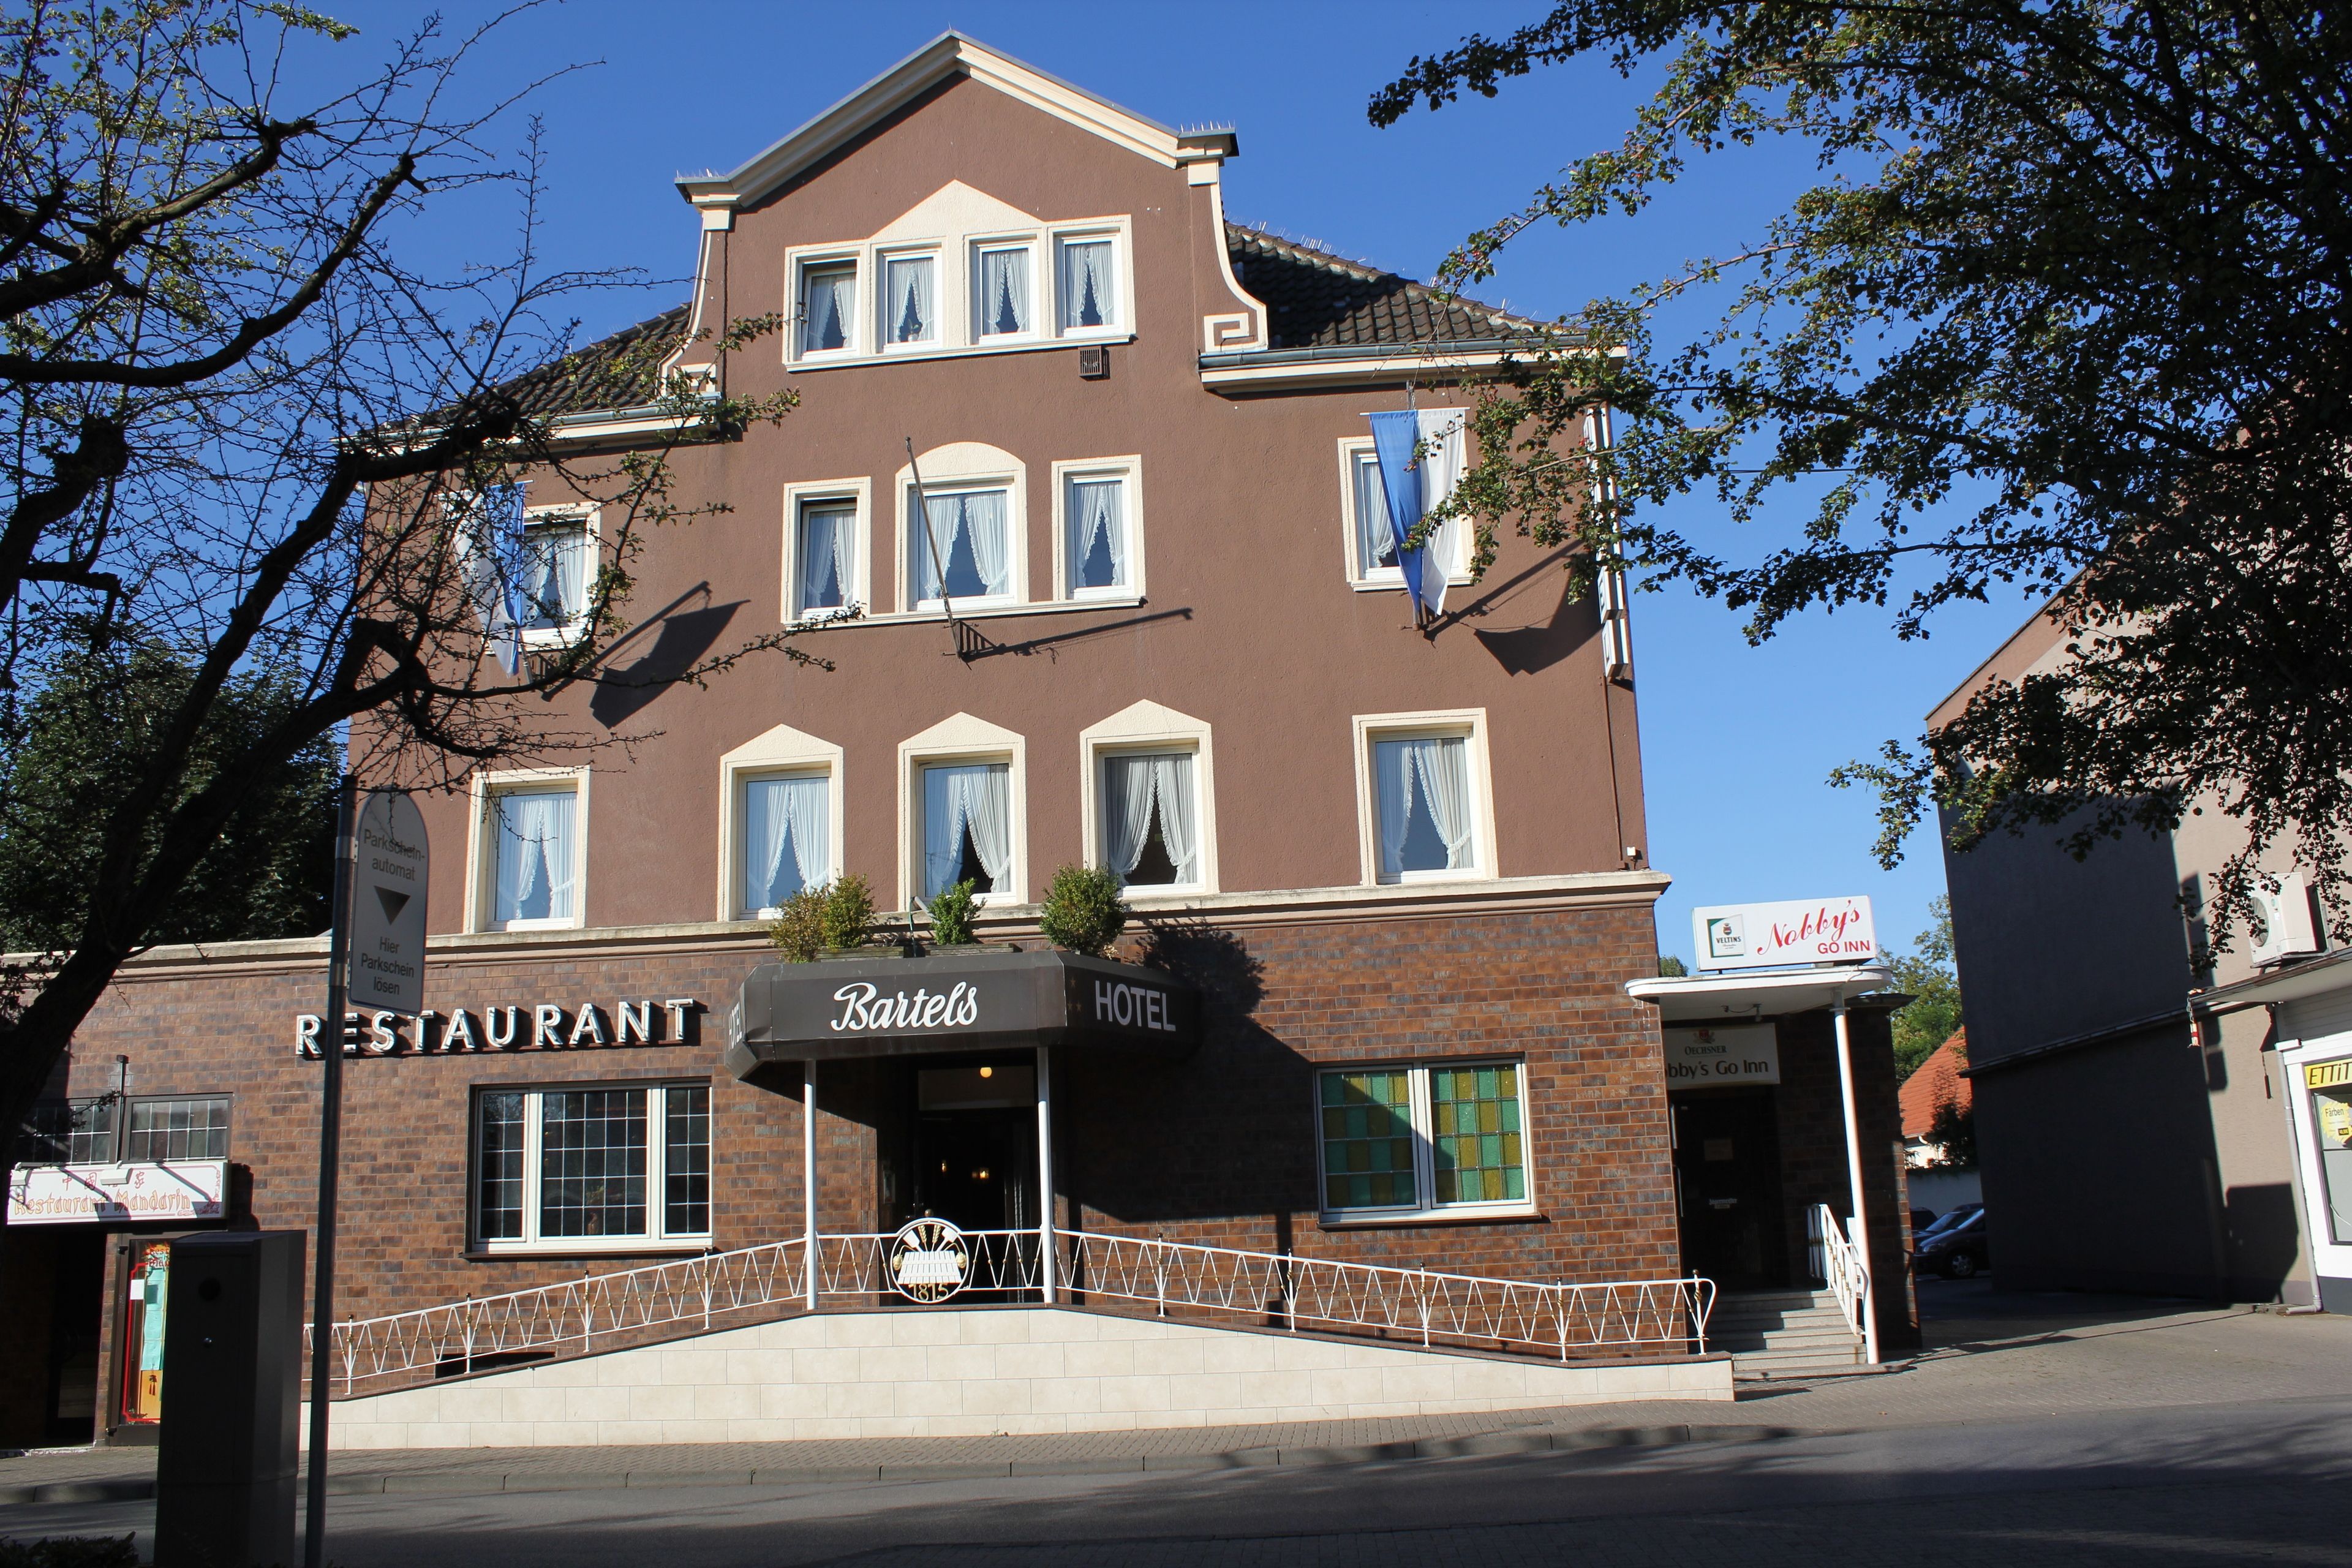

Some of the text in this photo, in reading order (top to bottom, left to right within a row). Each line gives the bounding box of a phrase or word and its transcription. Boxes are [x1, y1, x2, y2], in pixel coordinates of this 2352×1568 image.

[363, 828, 425, 862] Parkschein-
[371, 858, 416, 881] automat
[1757, 899, 1860, 956] Nobby's
[379, 936, 400, 954] Hier
[1817, 940, 1871, 955] GO INN
[360, 952, 415, 978] Parkschein
[372, 976, 401, 995] lösen
[830, 981, 978, 1031] Bartels
[1095, 980, 1177, 1032] HOTEL
[295, 998, 695, 1055] RESTAURANT
[1684, 1045, 1727, 1056] OECHSNER
[1665, 1058, 1769, 1080] bby's Go Inn
[15, 1186, 191, 1215] Restaurant Mandarin
[908, 1284, 949, 1302] 1815
